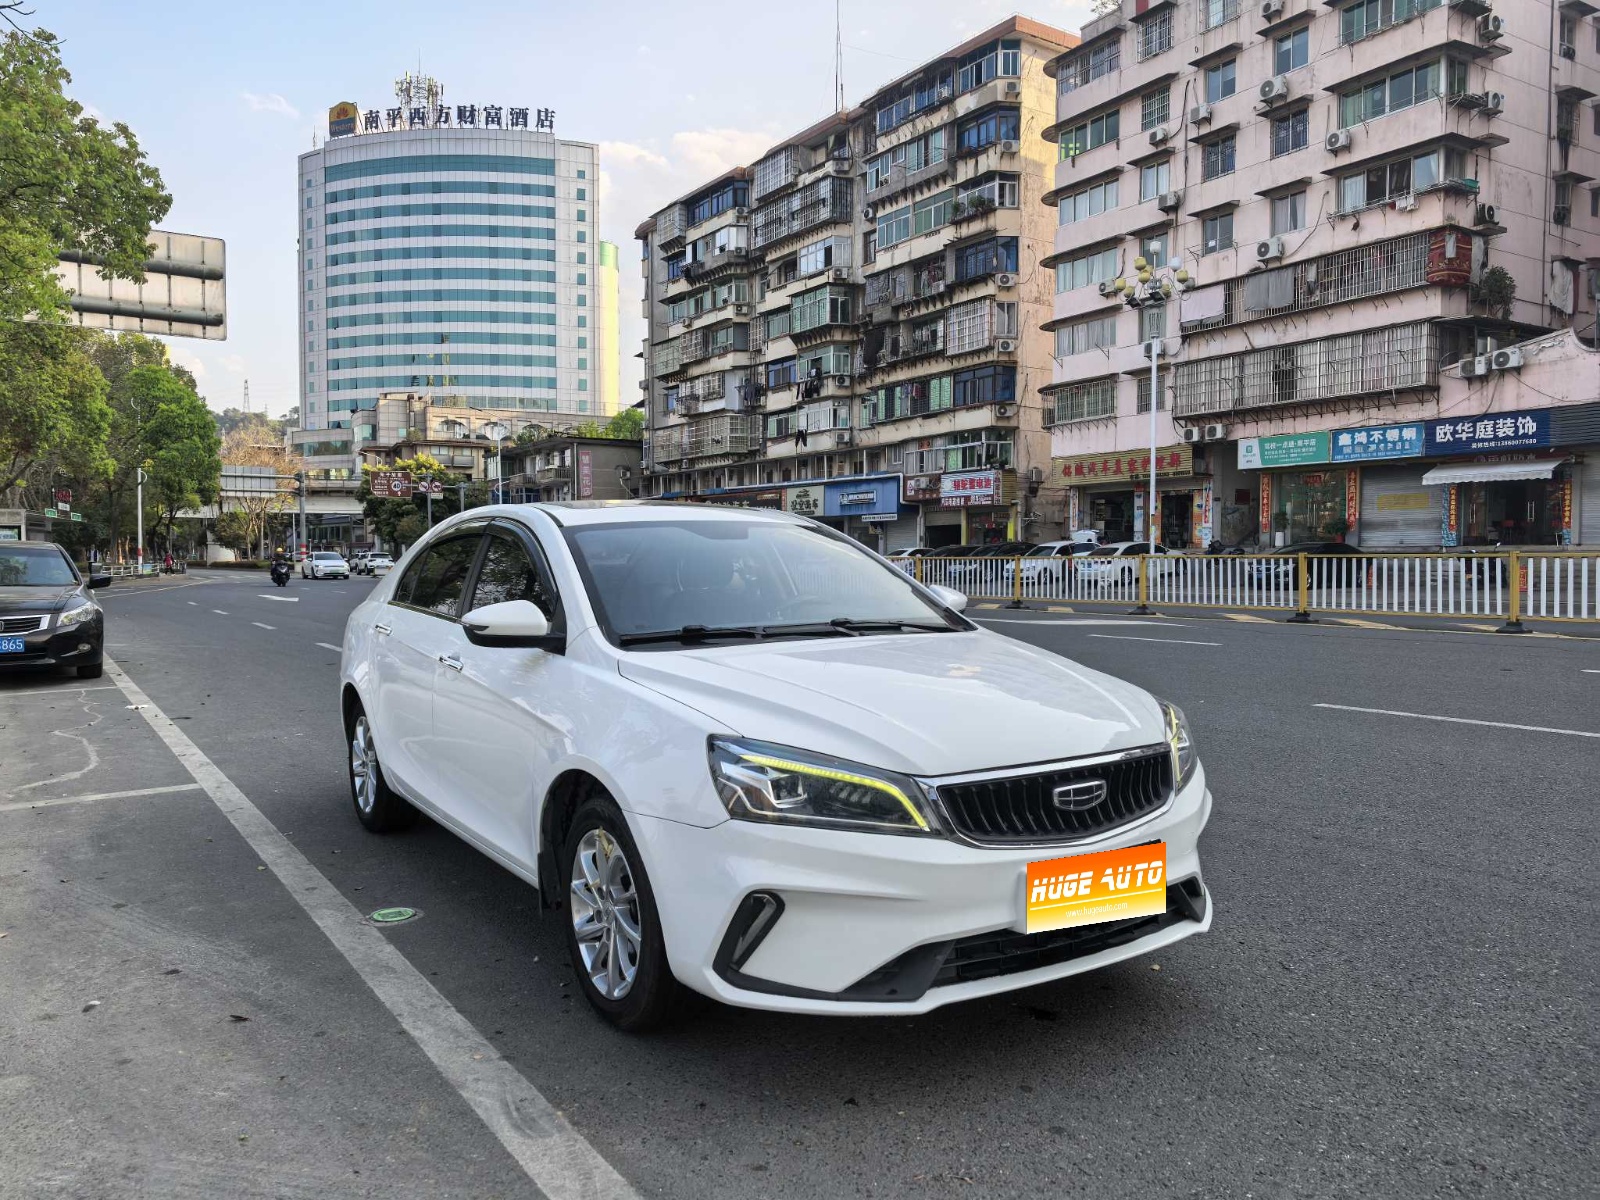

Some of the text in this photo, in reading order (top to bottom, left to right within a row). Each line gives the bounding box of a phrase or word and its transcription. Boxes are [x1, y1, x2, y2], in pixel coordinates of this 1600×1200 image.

[363, 104, 555, 130] 南平西方财富酒店
[1436, 416, 1537, 443] 欧华庭装饰
[0, 639, 23, 650] 865
